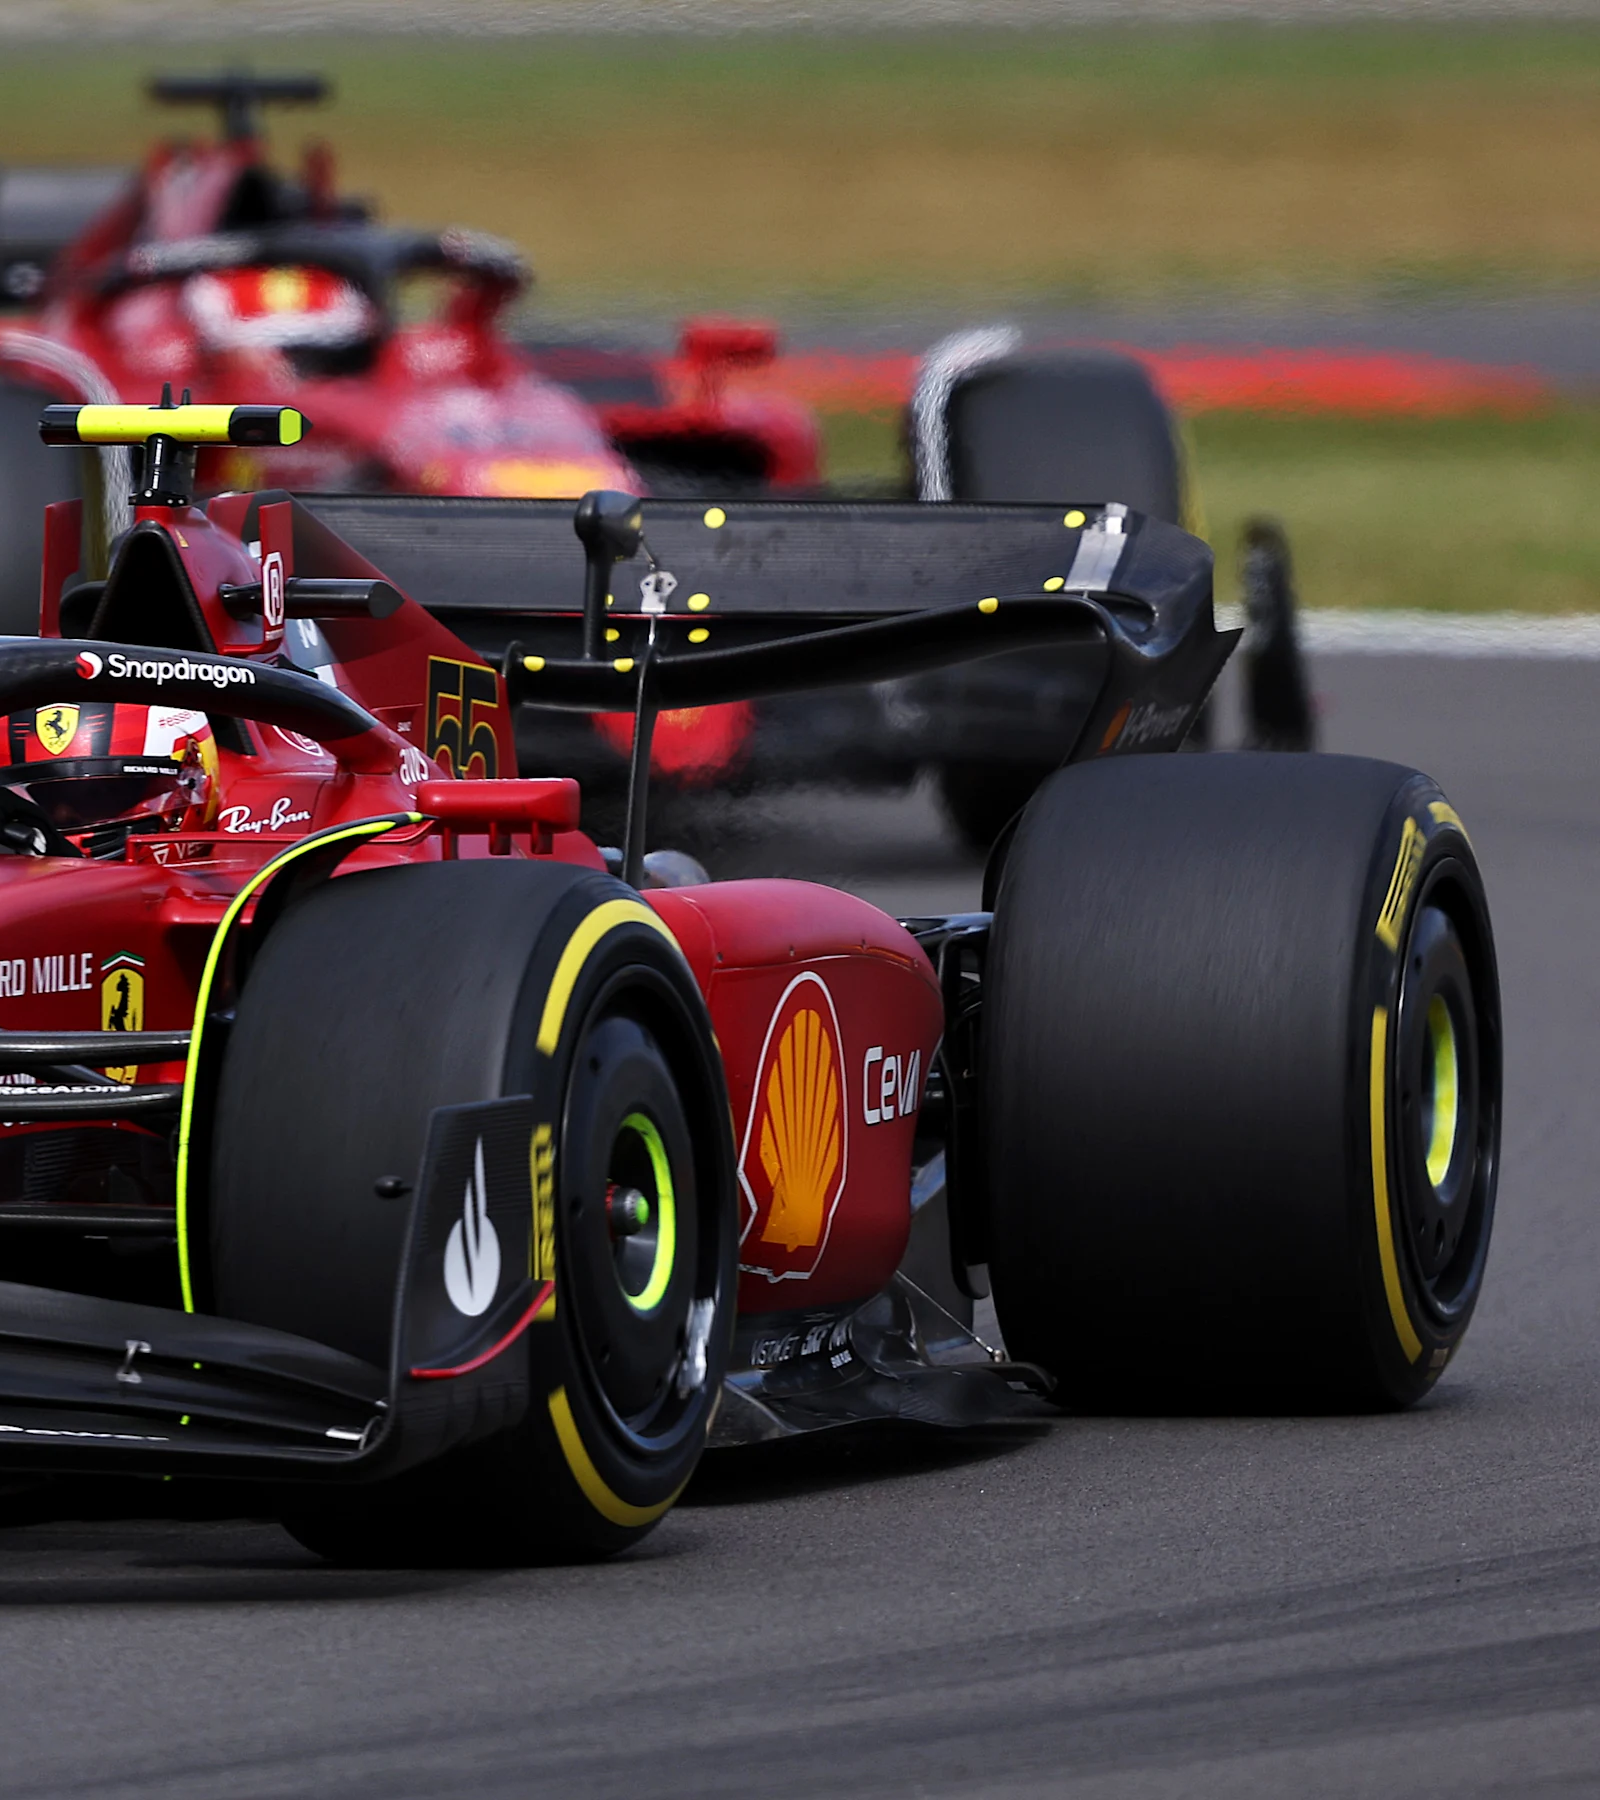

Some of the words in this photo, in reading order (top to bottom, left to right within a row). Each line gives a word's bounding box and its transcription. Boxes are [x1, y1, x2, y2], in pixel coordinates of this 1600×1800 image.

[107, 653, 256, 689] Snapdragon
[425, 655, 498, 781] 55
[399, 746, 429, 786] aws
[32, 953, 93, 993] MILLE
